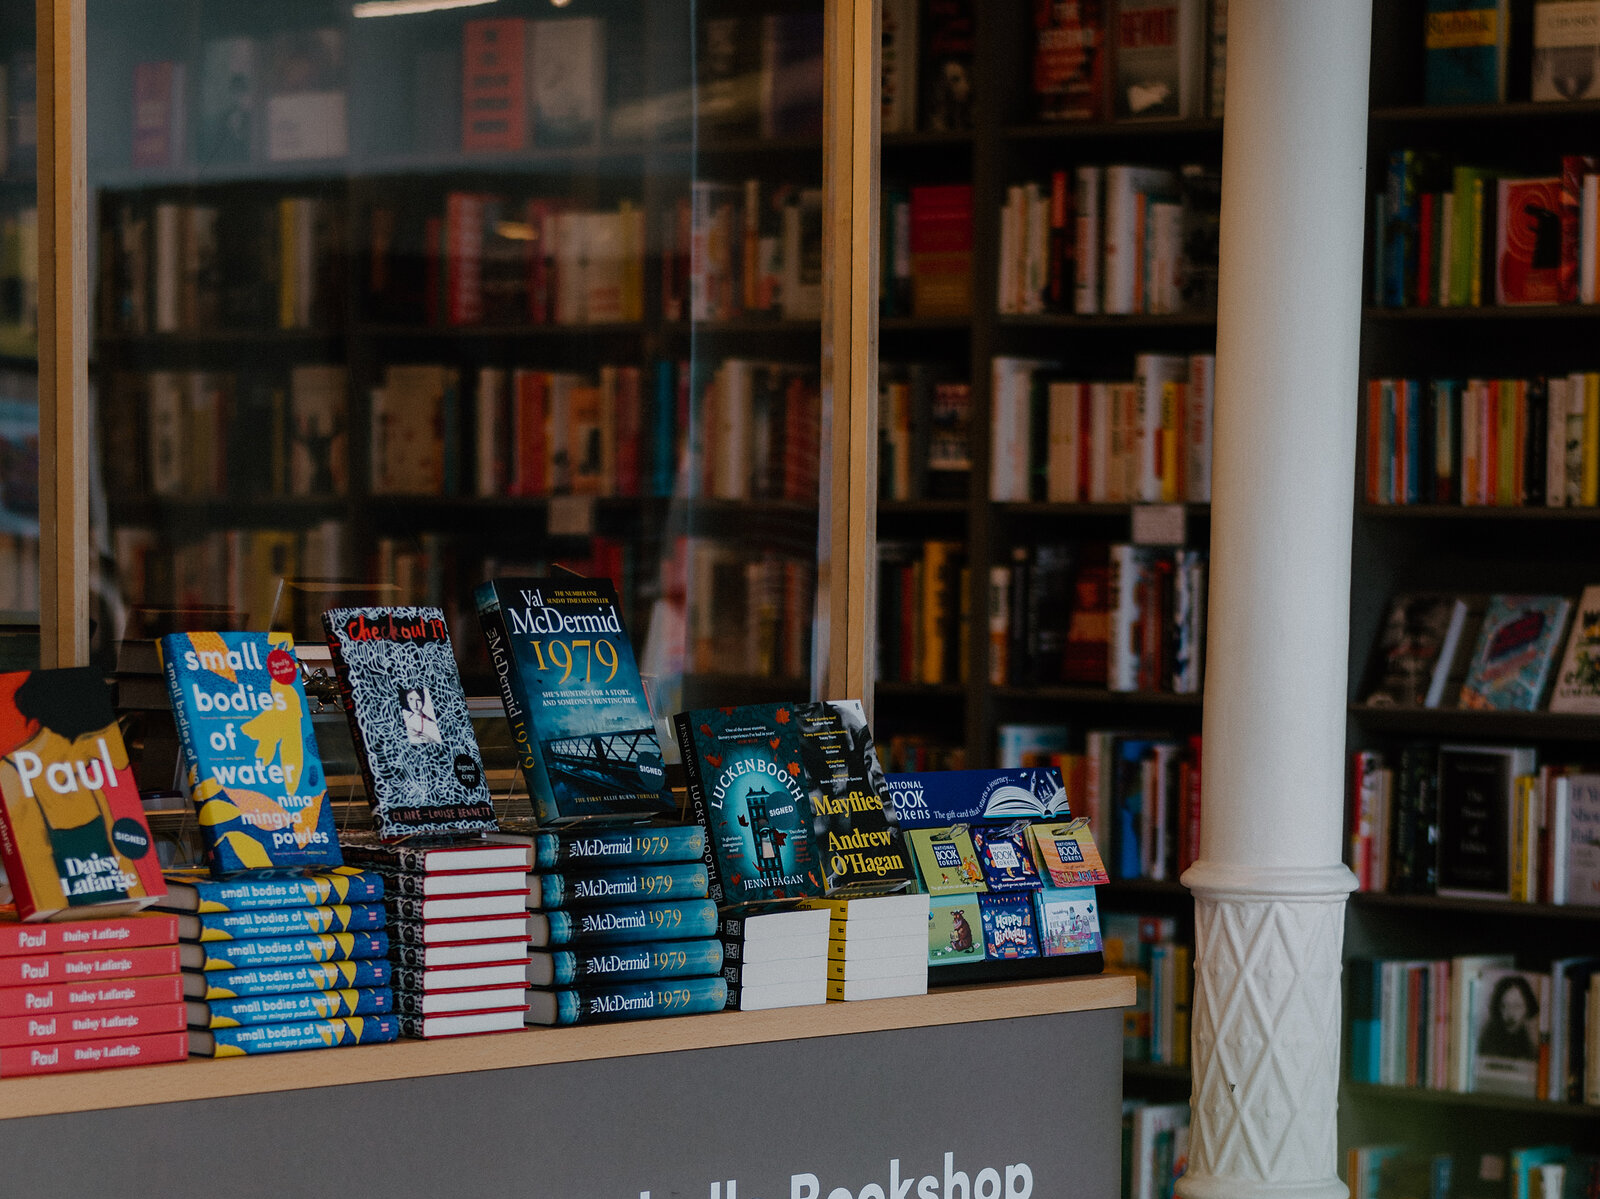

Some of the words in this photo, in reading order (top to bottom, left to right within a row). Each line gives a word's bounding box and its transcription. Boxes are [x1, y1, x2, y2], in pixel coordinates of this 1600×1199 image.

[520, 588, 544, 607] Val
[428, 619, 447, 640] 19
[508, 605, 622, 634] McDermid
[486, 627, 498, 640] Val
[184, 642, 262, 671] small
[530, 639, 619, 684] 1979
[488, 636, 523, 719] McDermid
[192, 684, 288, 712] bodies
[556, 698, 594, 706] SOMEONE'S
[560, 690, 590, 698] HUNTING
[166, 662, 183, 697] small
[176, 701, 192, 745] bodies
[186, 747, 198, 761] of
[210, 723, 236, 751] of
[680, 722, 691, 747] JENNI
[514, 722, 535, 769] 1979
[14, 738, 118, 798] Paul
[211, 760, 296, 785] water
[456, 763, 476, 774] signed
[462, 772, 475, 782] copy
[639, 764, 662, 776] SIGNED
[711, 758, 805, 810] LUCKENBOOTH
[278, 792, 313, 808] nina
[812, 791, 883, 818] Mayflies
[890, 790, 928, 808] OOK
[933, 811, 946, 819] The
[946, 810, 956, 820] gift
[956, 810, 969, 818] card
[969, 806, 981, 817] that
[979, 790, 988, 810] starts
[242, 812, 302, 829] mingya
[459, 806, 491, 818] BENNETT
[769, 804, 794, 818] SIGNED
[114, 831, 147, 846] SIGNED
[272, 831, 329, 849] powles
[569, 842, 577, 858] Val
[576, 836, 632, 857] McDermid
[636, 836, 669, 856] 1979
[828, 829, 891, 852] Andrew
[935, 850, 958, 860] BOOK
[993, 850, 1016, 860] BOOK
[1057, 846, 1080, 856] BOOK
[64, 853, 120, 877] Daisy
[830, 852, 904, 876] O'Hagan
[60, 868, 138, 896] Lafarge
[221, 883, 250, 899] small
[251, 883, 286, 897] bodies
[289, 883, 300, 894] of
[581, 876, 637, 897] McDermid
[641, 874, 673, 895] 1979
[743, 878, 772, 890] JENNI
[772, 874, 804, 888] FAGAN
[224, 911, 252, 926] small
[254, 911, 290, 925] bodies
[292, 911, 302, 922] of
[582, 918, 590, 932] Val
[588, 910, 646, 931] McDermid
[650, 908, 682, 928] 1979
[994, 914, 1022, 929] Happy
[19, 930, 46, 948] Paul
[63, 930, 92, 942] Daisy
[92, 928, 130, 940] Lafarge
[994, 926, 1028, 947] Birthday
[227, 941, 256, 957] small
[258, 940, 292, 955] bodies
[294, 940, 305, 952] of
[21, 961, 49, 979] Paul
[66, 961, 94, 974] Daisy
[95, 959, 132, 972] Lafarge
[587, 959, 595, 974] Val
[593, 952, 650, 973] McDermid
[654, 950, 686, 971] 1979
[229, 970, 258, 986] small
[259, 970, 294, 984] bodies
[296, 969, 307, 980] of
[26, 991, 53, 1009] Paul
[69, 990, 97, 1004] Daisy
[98, 988, 136, 1000] Lafarge
[232, 998, 260, 1014] small
[262, 998, 298, 1012] bodies
[299, 998, 310, 1008] of
[590, 999, 598, 1014] Val
[597, 990, 654, 1012] McDermid
[657, 988, 690, 1010] 1979
[28, 1018, 56, 1036] Paul
[72, 1018, 100, 1030] Daisy
[102, 1016, 140, 1028] Lafarge
[236, 1026, 266, 1042] small
[267, 1026, 302, 1040] bodies
[304, 1024, 314, 1036] of
[31, 1048, 59, 1066] Paul
[74, 1048, 102, 1060] Daisy
[103, 1045, 140, 1058] Lafarge
